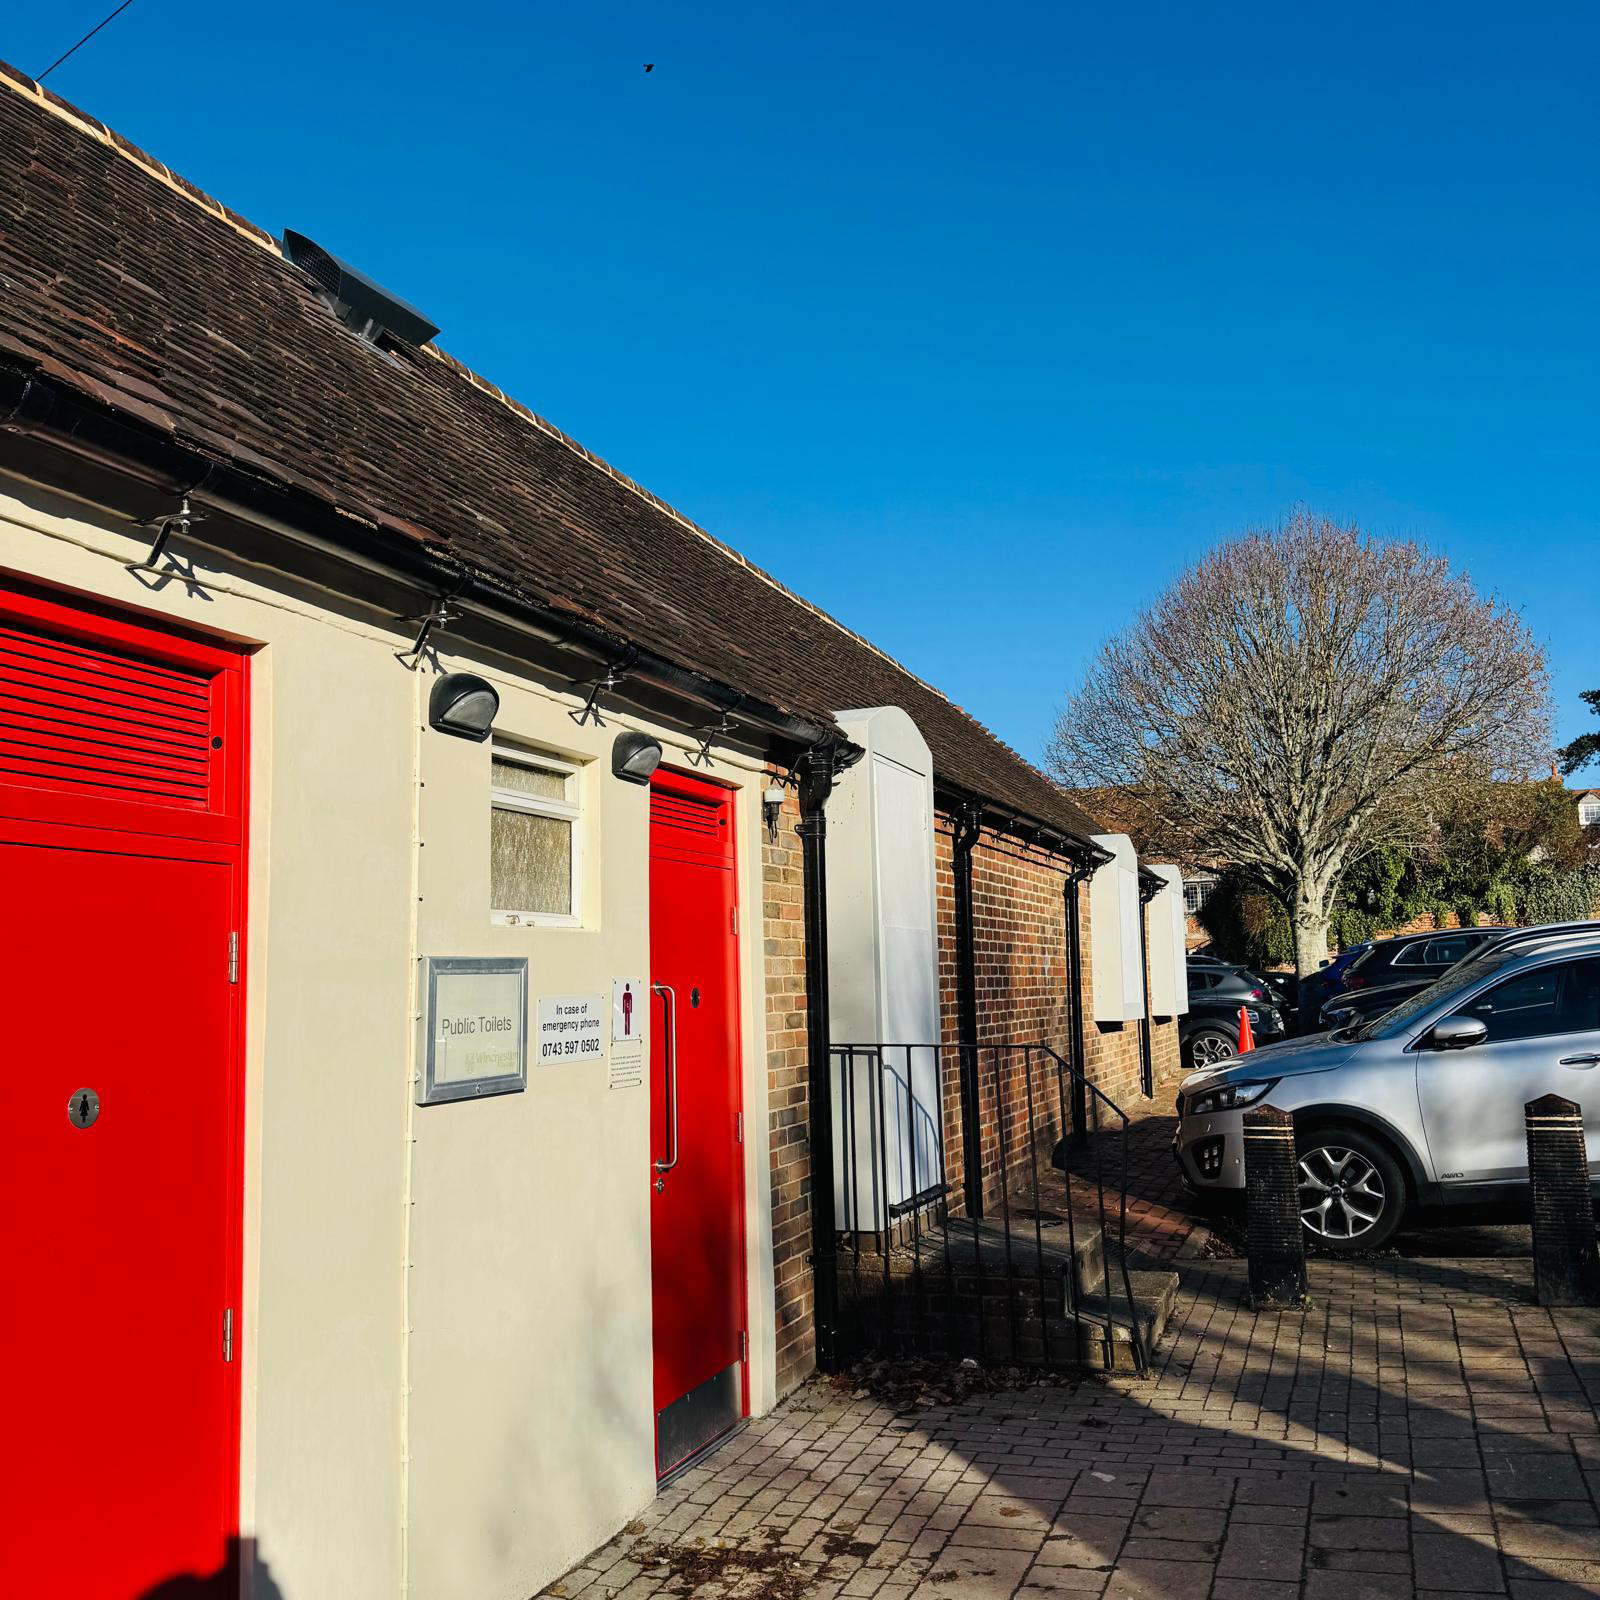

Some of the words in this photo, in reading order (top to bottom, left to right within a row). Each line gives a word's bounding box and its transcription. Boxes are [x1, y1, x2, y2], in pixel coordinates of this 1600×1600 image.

[556, 1005, 563, 1015] In
[564, 1006, 580, 1015] case
[580, 1003, 588, 1014] of
[442, 1018, 475, 1035] Public
[478, 1016, 512, 1032] Toilets
[542, 1020, 578, 1032] emergency
[580, 1018, 600, 1030] phone
[542, 1042, 562, 1057] 0743
[564, 1040, 579, 1054] 597
[581, 1038, 600, 1052] 0502
